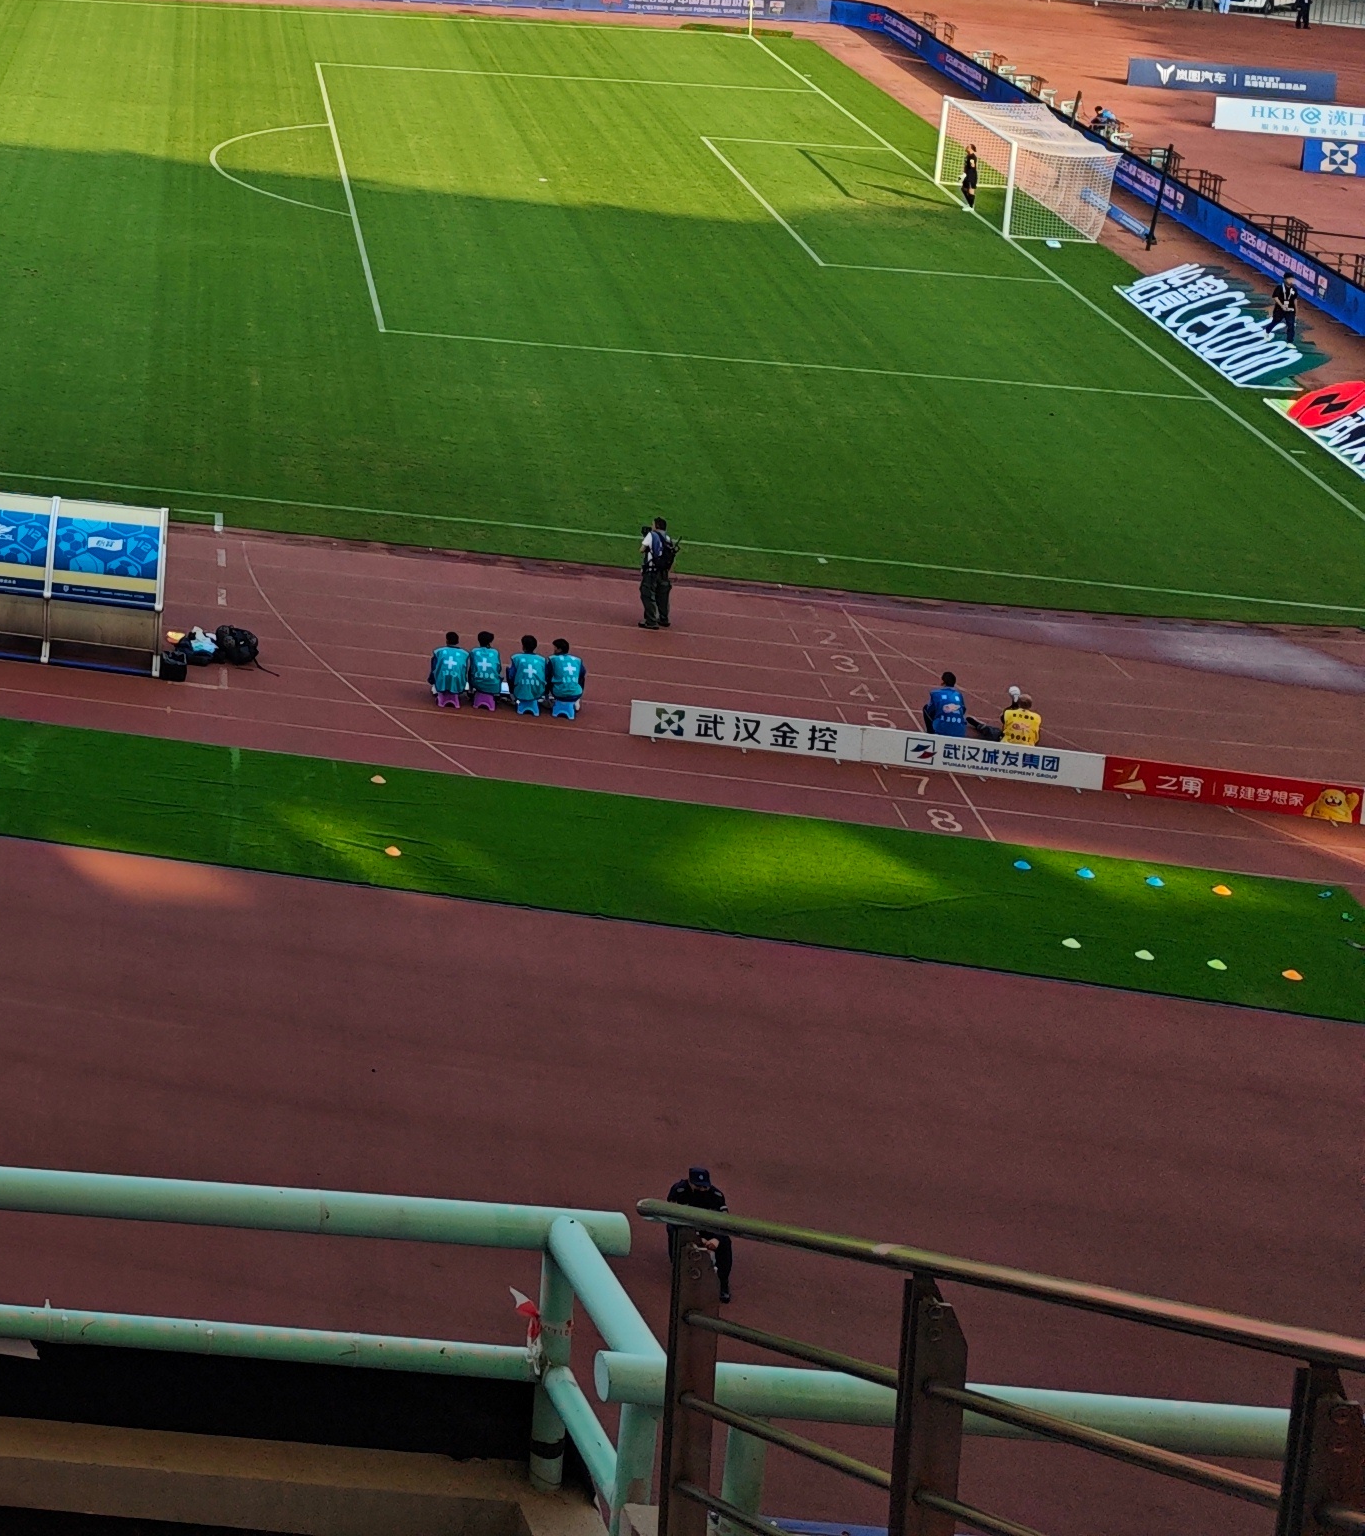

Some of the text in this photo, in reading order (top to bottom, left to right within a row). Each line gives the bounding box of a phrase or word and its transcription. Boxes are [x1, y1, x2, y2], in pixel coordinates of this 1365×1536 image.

[1251, 105, 1296, 120] HKB
[815, 629, 843, 647] 2
[830, 654, 860, 673] 3
[849, 683, 879, 702] 4
[866, 711, 896, 729] 5
[695, 713, 838, 753] 武汉金控
[942, 743, 1061, 773] 武汉城发集团
[942, 761, 1058, 780] WUHAN URBAN DEVELOPMENT GROUP
[901, 774, 930, 796] 7
[926, 808, 963, 833] 8
